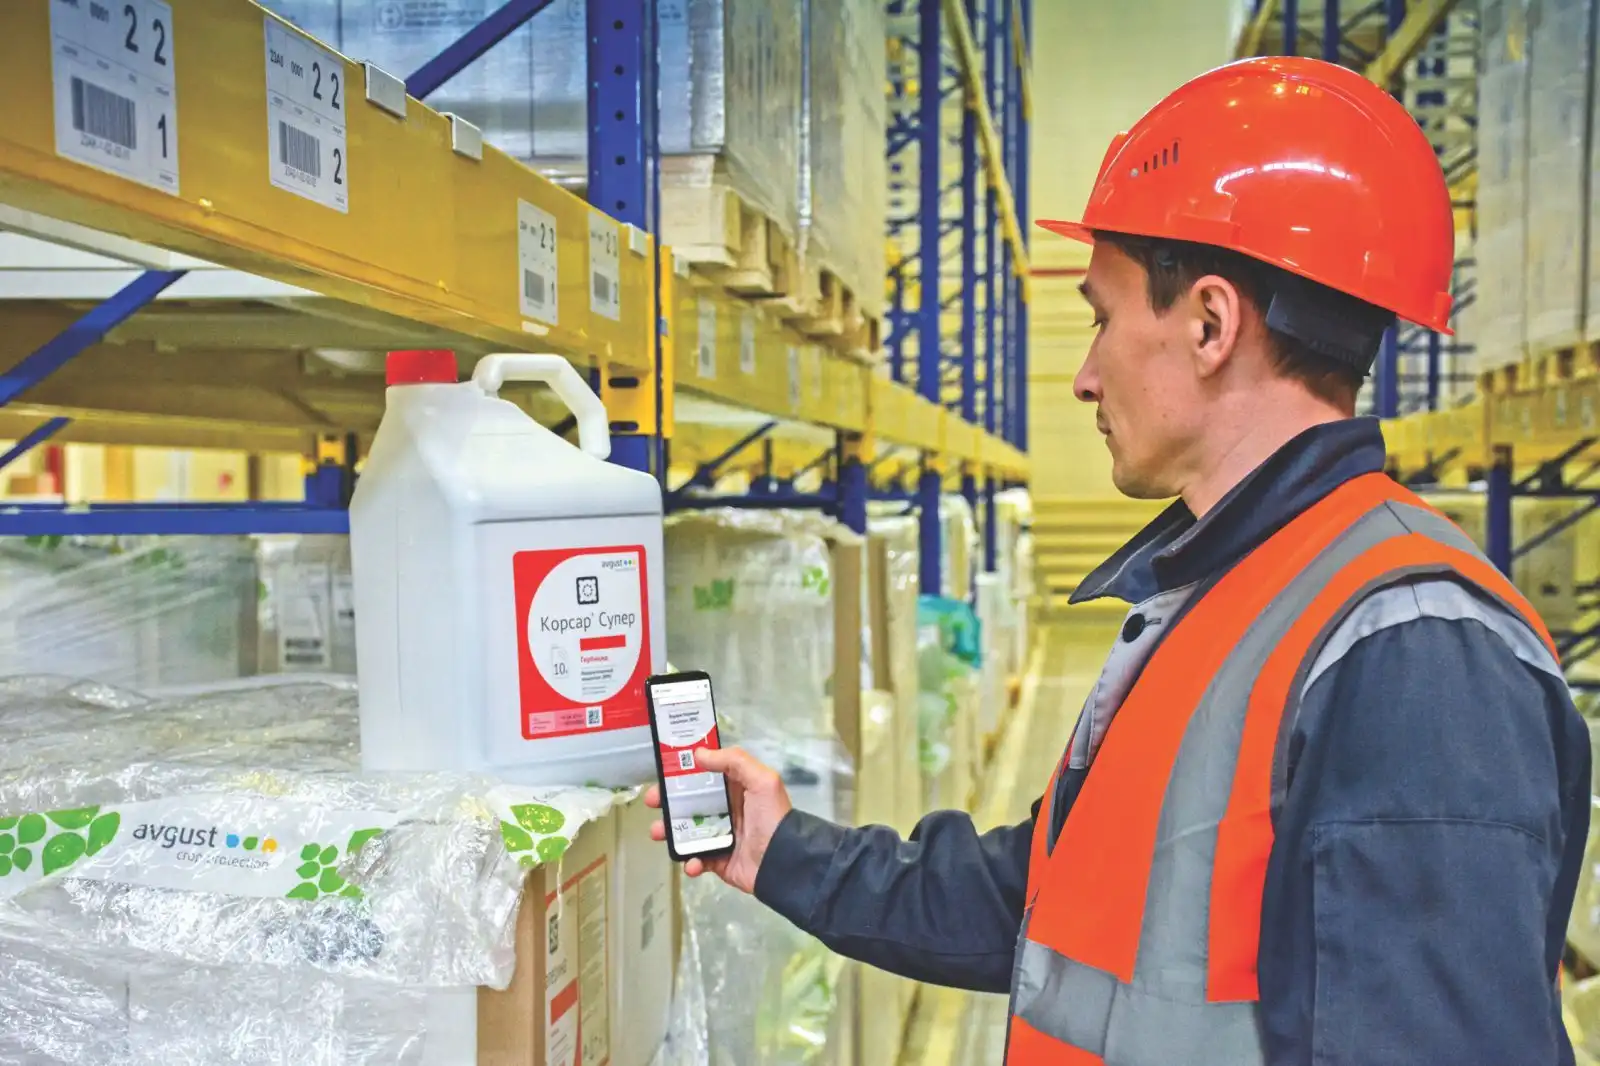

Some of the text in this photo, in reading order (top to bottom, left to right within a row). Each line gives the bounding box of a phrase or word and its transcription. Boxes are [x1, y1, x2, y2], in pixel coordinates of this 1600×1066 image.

[124, 4, 139, 53] 2
[153, 18, 167, 66] 2
[312, 61, 322, 101] 2
[331, 72, 340, 110] 2
[157, 113, 168, 158] 1
[333, 148, 342, 185] 2
[540, 222, 546, 249] 2
[601, 559, 622, 570] avgust
[598, 611, 635, 630] Супер
[132, 823, 218, 849] avgust
